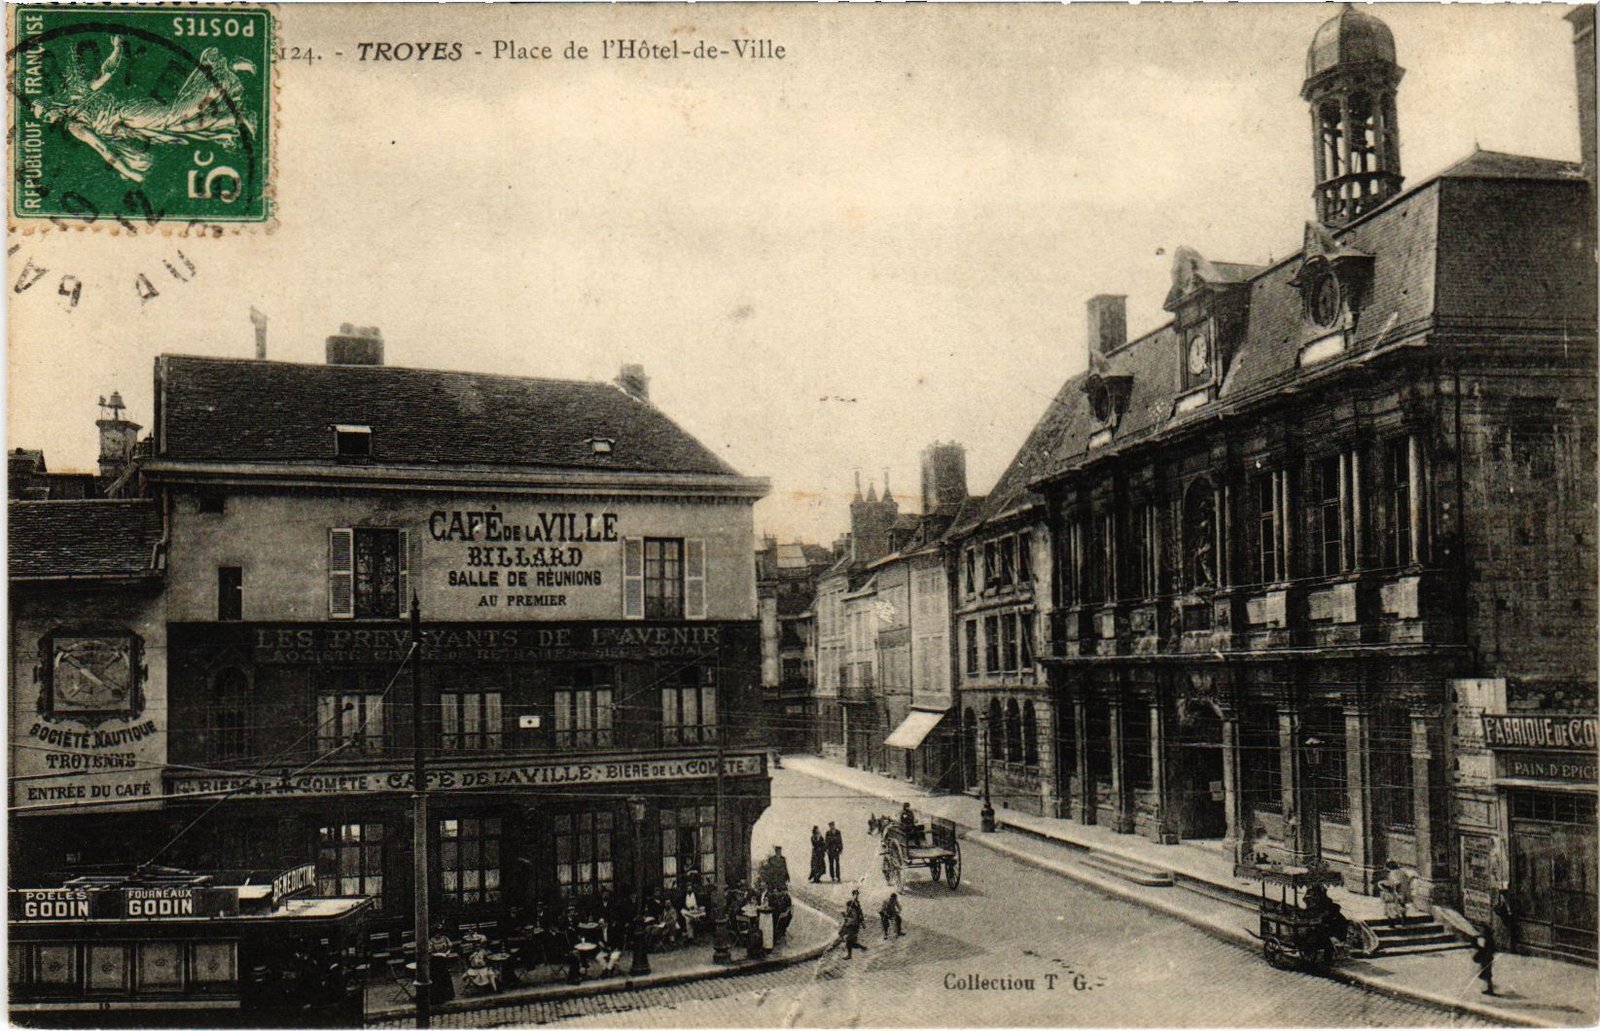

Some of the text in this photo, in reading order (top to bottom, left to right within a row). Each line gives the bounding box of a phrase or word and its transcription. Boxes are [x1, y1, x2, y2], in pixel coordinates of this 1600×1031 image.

[172, 17, 255, 37] POSTES
[428, 504, 618, 542] CAFÉ DE LA VILLE
[467, 546, 583, 568] BILLARD
[449, 569, 602, 587] SALLE DE RÉUNIONS
[478, 595, 567, 607] AU PREMIER
[256, 629, 313, 649] LES
[538, 628, 571, 647] DE
[29, 721, 157, 749] SOCIÉTÉ NAUTIQUE
[1484, 717, 1552, 746] FABRIQUE
[1554, 725, 1569, 747] DE
[46, 752, 136, 770] TROYENNE
[1514, 762, 1544, 775] PAIN
[519, 765, 593, 784] VILLE
[652, 765, 668, 777] DE
[669, 764, 684, 777] LA
[27, 780, 151, 801] ENTRÉE DU CAFÉ
[128, 890, 192, 898] FOURNEAUX
[24, 899, 193, 917] GODIN GODIN
